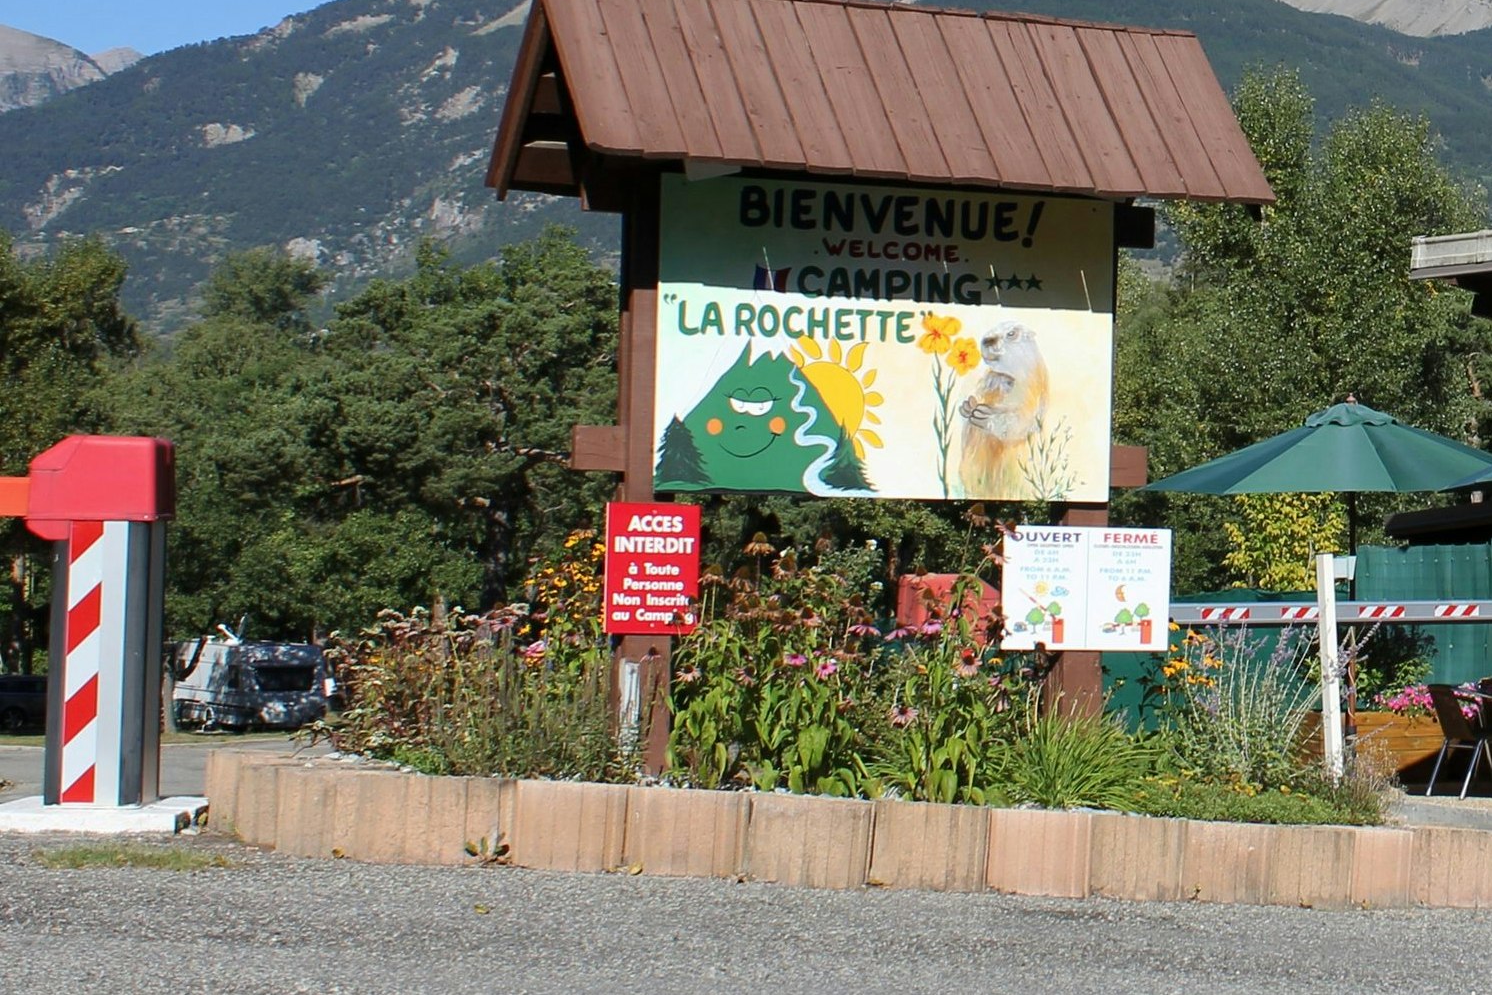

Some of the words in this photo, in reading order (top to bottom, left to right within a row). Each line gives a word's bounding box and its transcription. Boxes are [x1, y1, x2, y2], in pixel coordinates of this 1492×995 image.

[739, 185, 1045, 248] BIENVENUE!
[796, 265, 982, 305] CAMPING
[627, 515, 684, 533] ACCES
[1011, 532, 1082, 542] OUVERT
[1103, 531, 1159, 545] FERMÉ
[614, 536, 695, 554] INTERDIT
[628, 562, 638, 575] à
[644, 562, 680, 576] Toute
[623, 577, 684, 591] Personne
[612, 593, 640, 606] Non
[611, 610, 630, 621] au
[635, 608, 694, 625] Campg
